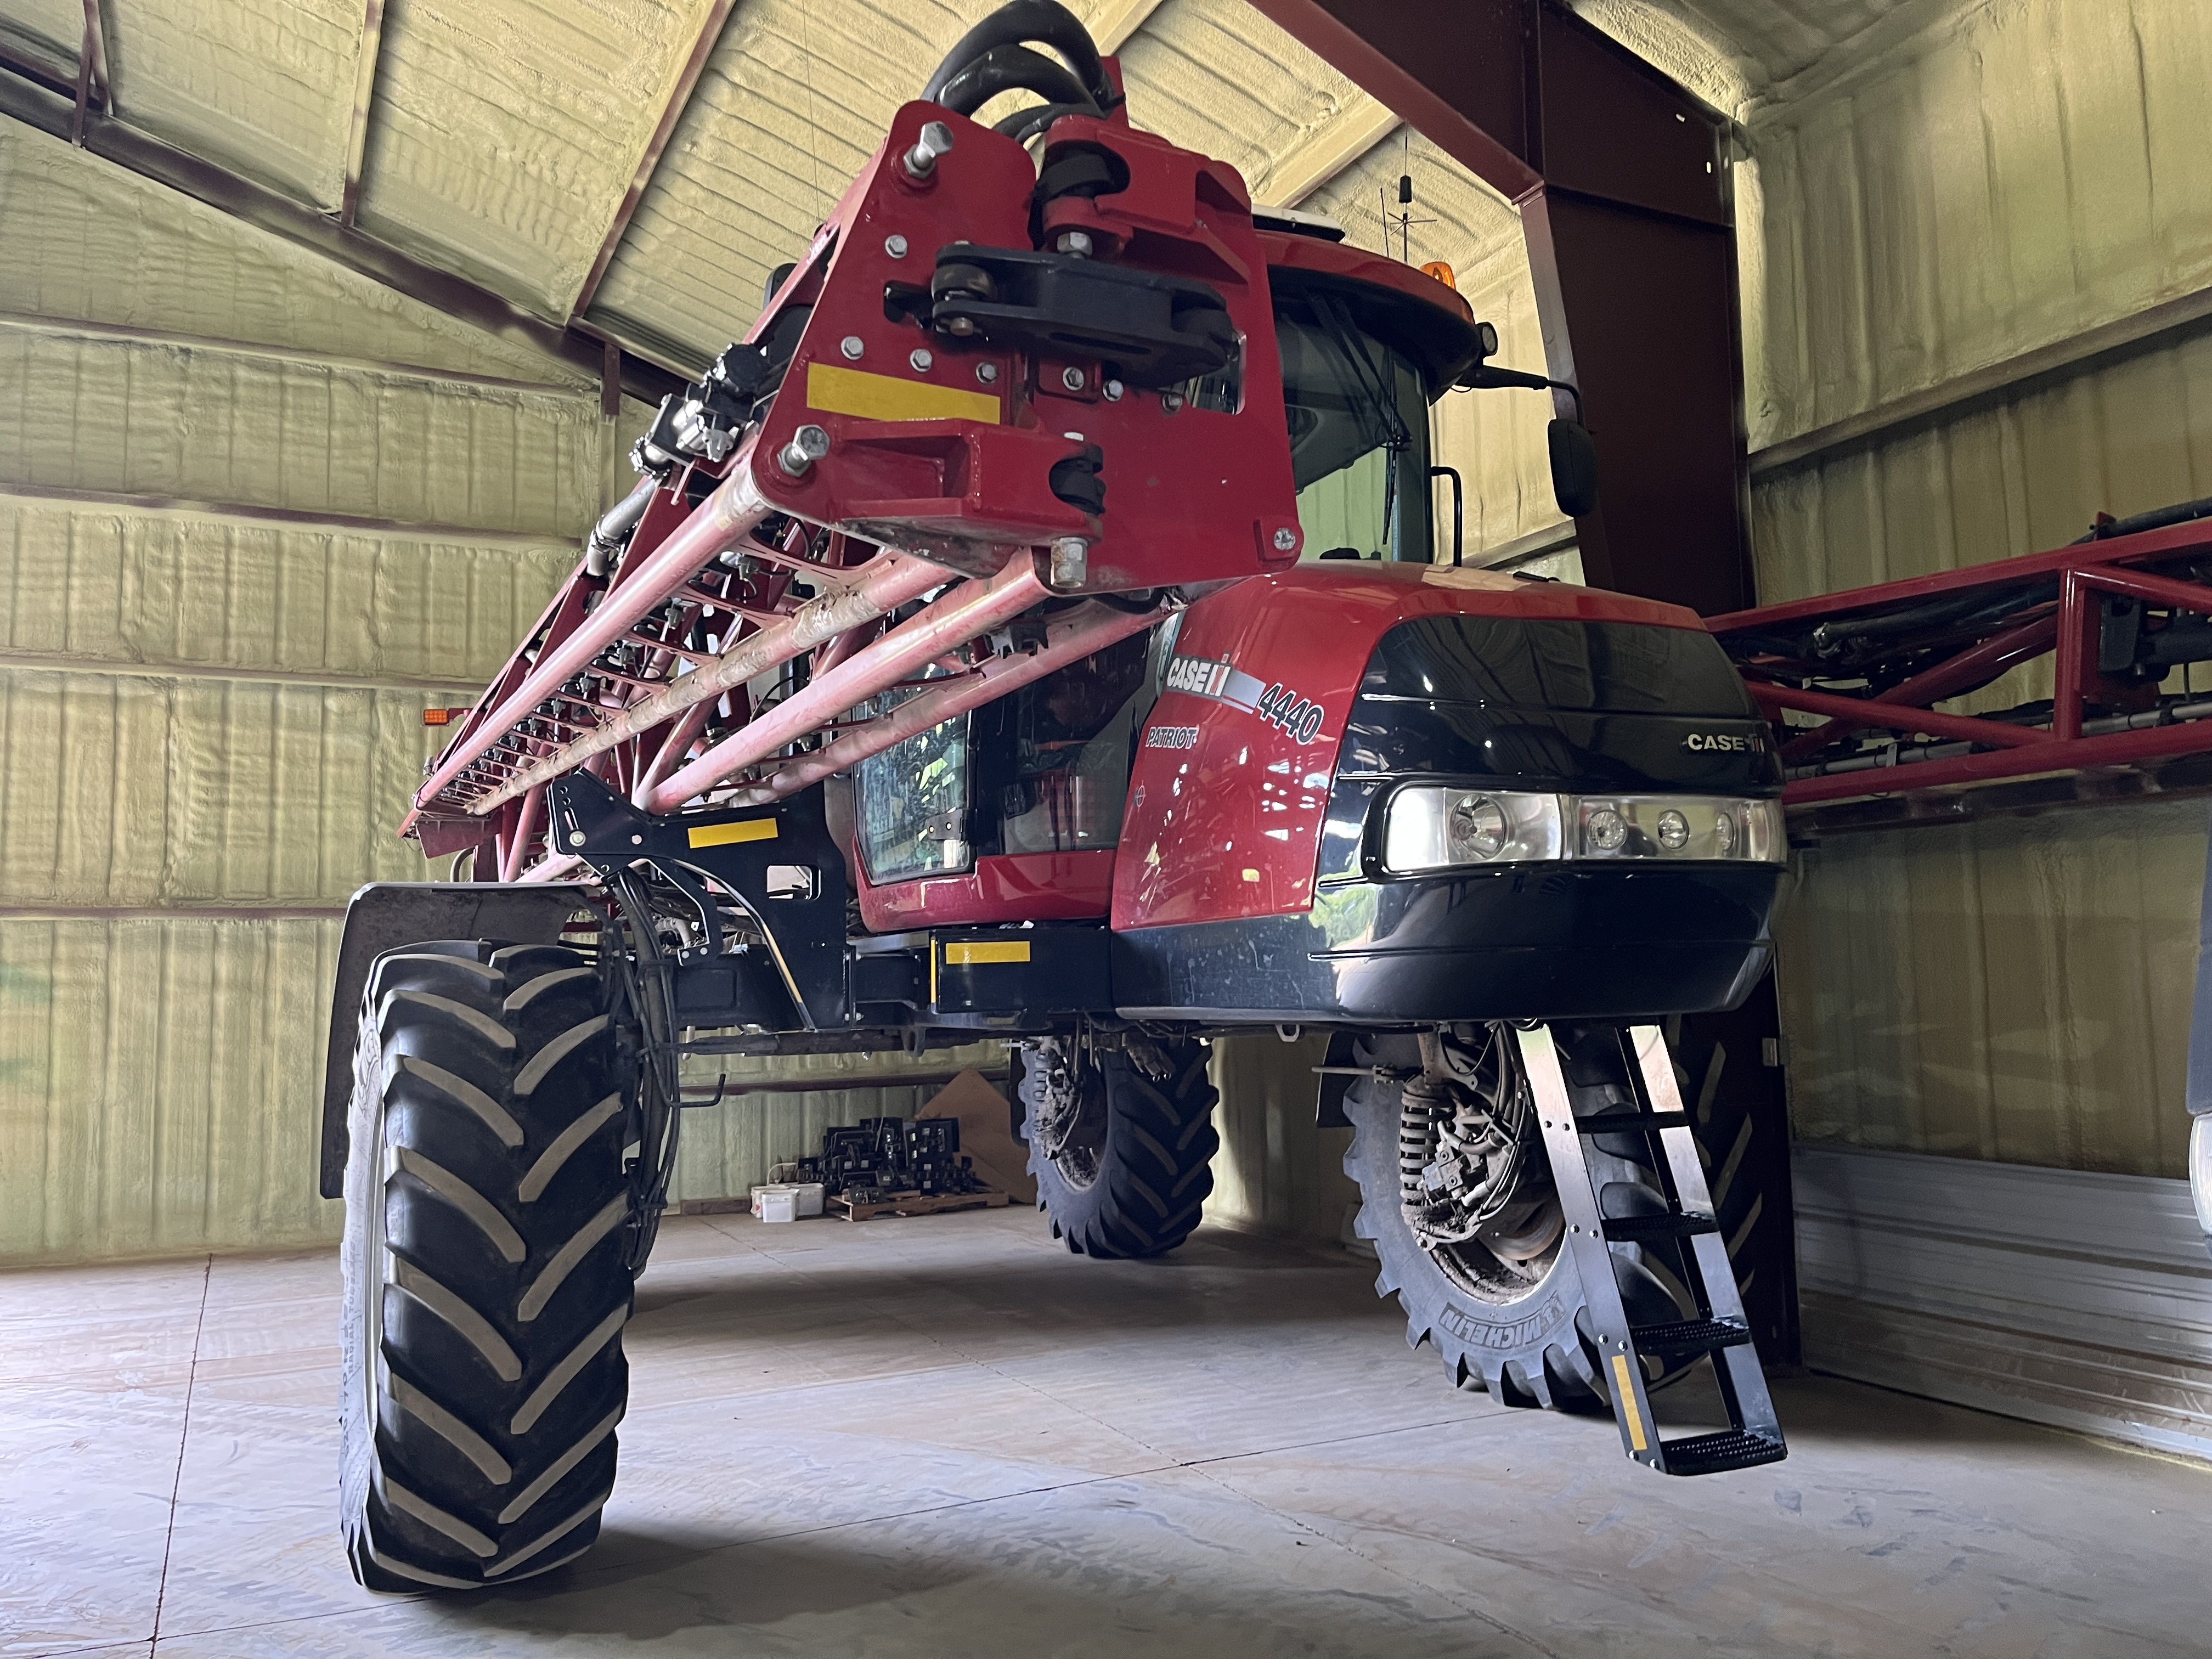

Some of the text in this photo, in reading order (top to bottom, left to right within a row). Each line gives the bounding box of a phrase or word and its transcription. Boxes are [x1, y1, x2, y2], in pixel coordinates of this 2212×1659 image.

[1167, 658, 1211, 693] CASE
[1256, 682, 1324, 745] 4440
[1145, 726, 1200, 749] PATRIOT
[1688, 733, 1745, 751] CASE
[1440, 1309, 1542, 1347] MICHELIN
